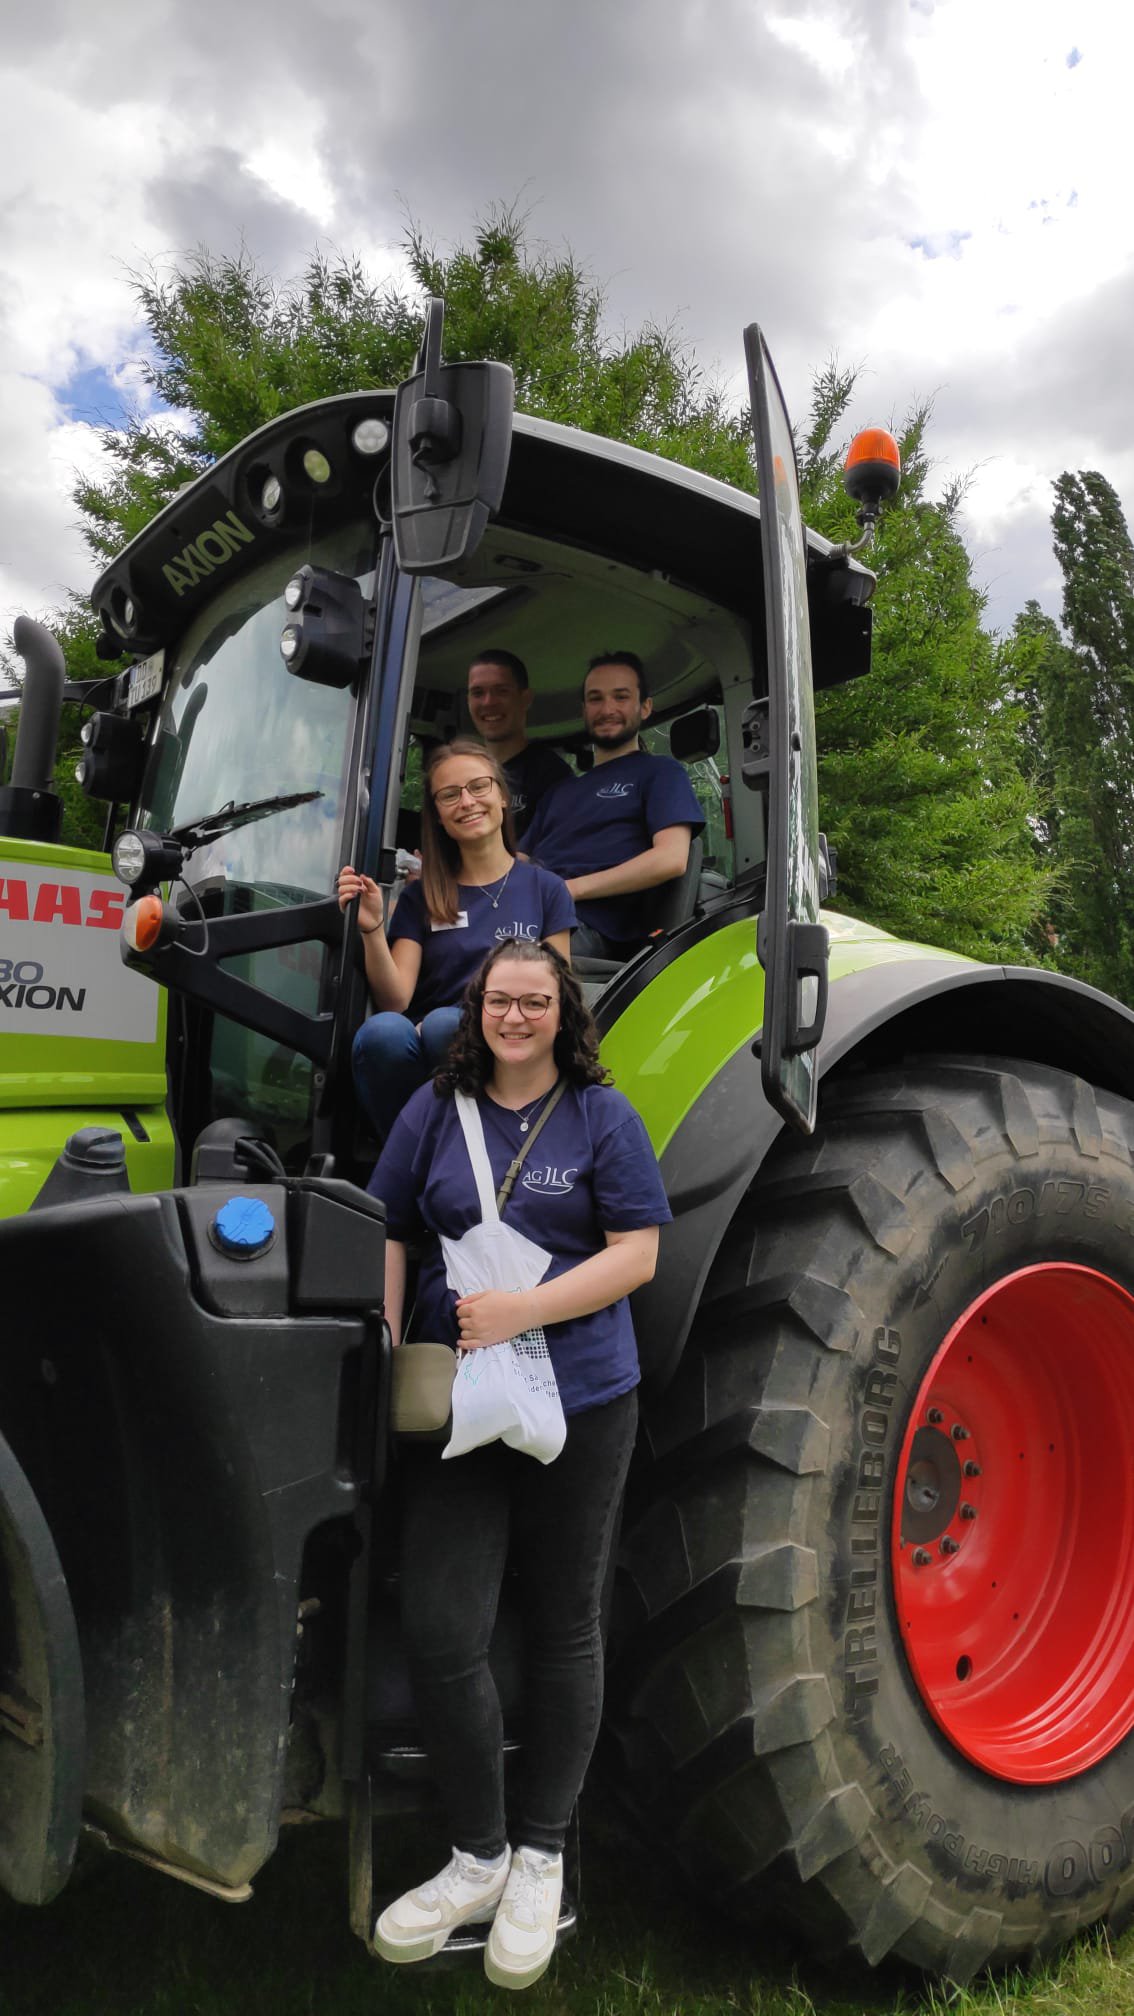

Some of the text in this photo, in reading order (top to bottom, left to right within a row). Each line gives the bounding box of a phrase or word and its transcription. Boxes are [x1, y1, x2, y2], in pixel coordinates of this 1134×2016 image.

[161, 510, 255, 597] AXION
[843, 1324, 901, 1715] TRELLEBORG
[878, 1740, 966, 1858] POWER
[962, 1842, 1041, 1886] HIGH
